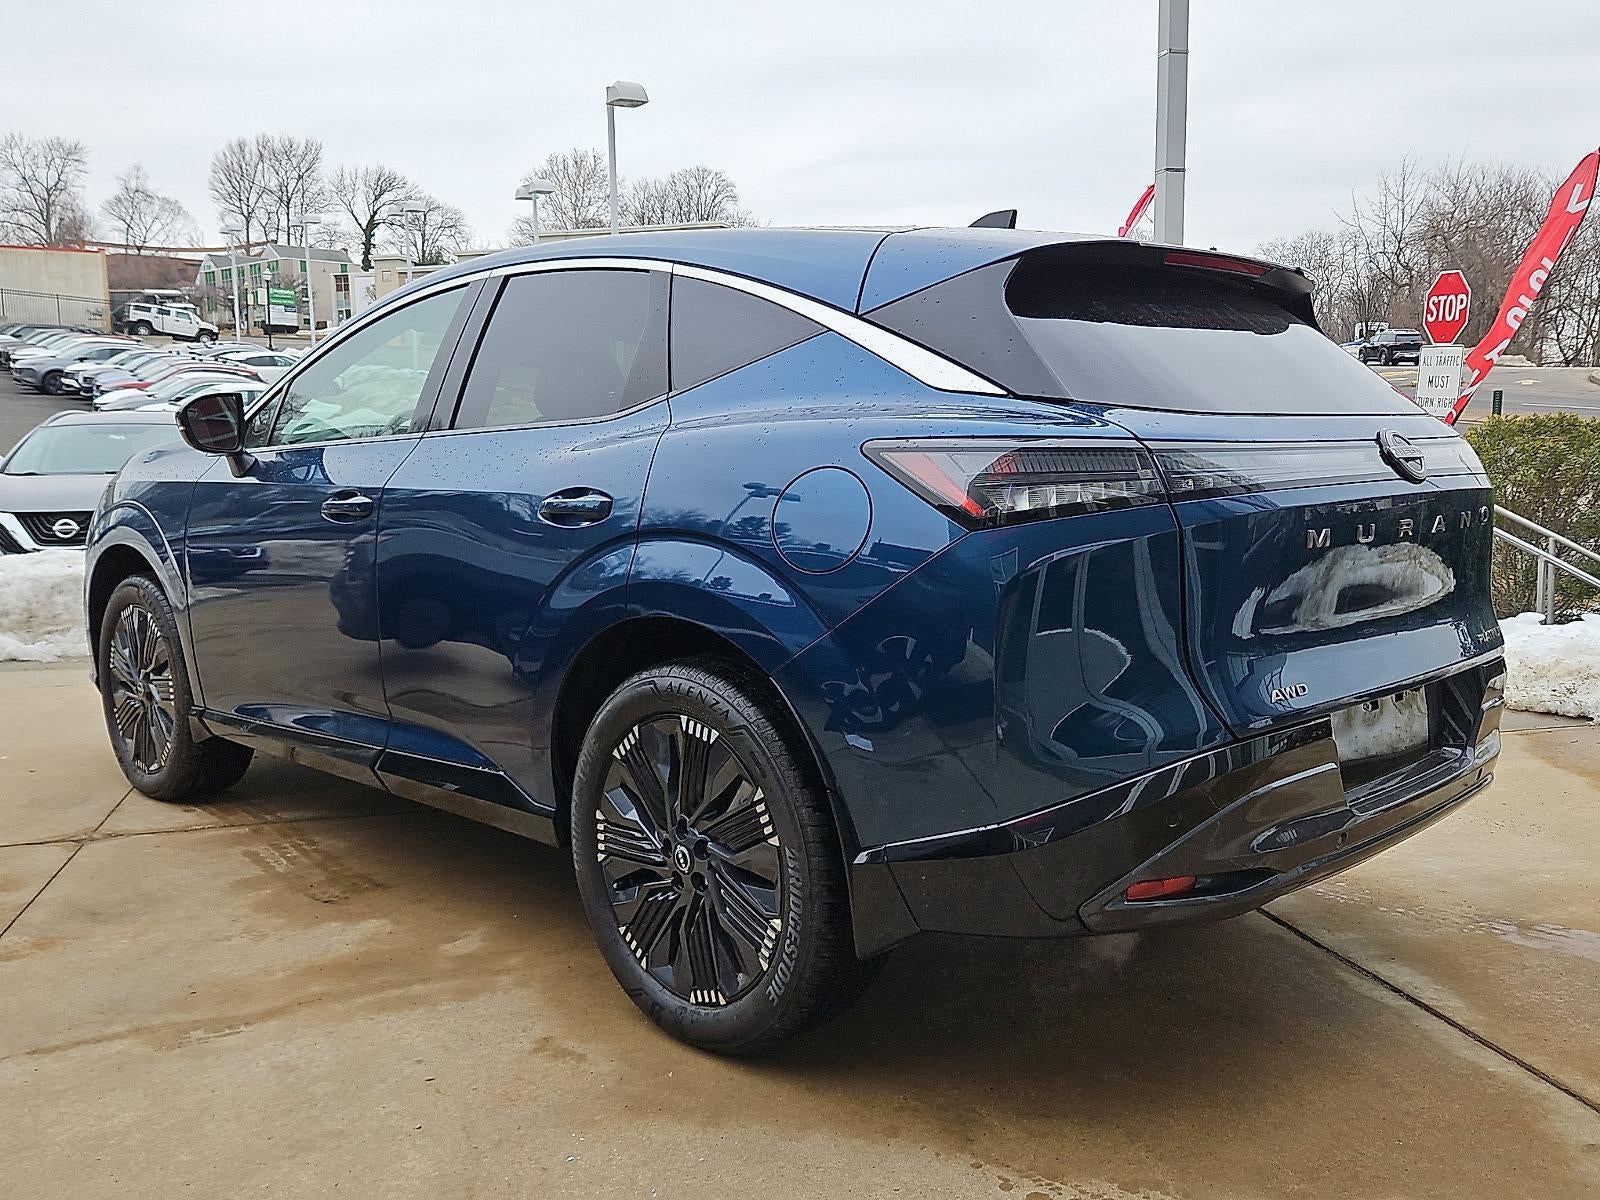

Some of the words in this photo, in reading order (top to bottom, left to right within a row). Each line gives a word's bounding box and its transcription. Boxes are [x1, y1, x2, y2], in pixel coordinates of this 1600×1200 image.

[1427, 293, 1467, 322] STOP
[1422, 355, 1433, 367] ALL
[1435, 355, 1460, 367] TRAFFIC
[1427, 375, 1450, 389] MUST
[1417, 396, 1434, 408] TURN
[1437, 397, 1456, 409] RIGHT
[1306, 505, 1490, 549] MURANO
[665, 681, 730, 720] ALENZA
[1271, 683, 1308, 704] AWD
[766, 846, 802, 1007] BRIDGESTONE
